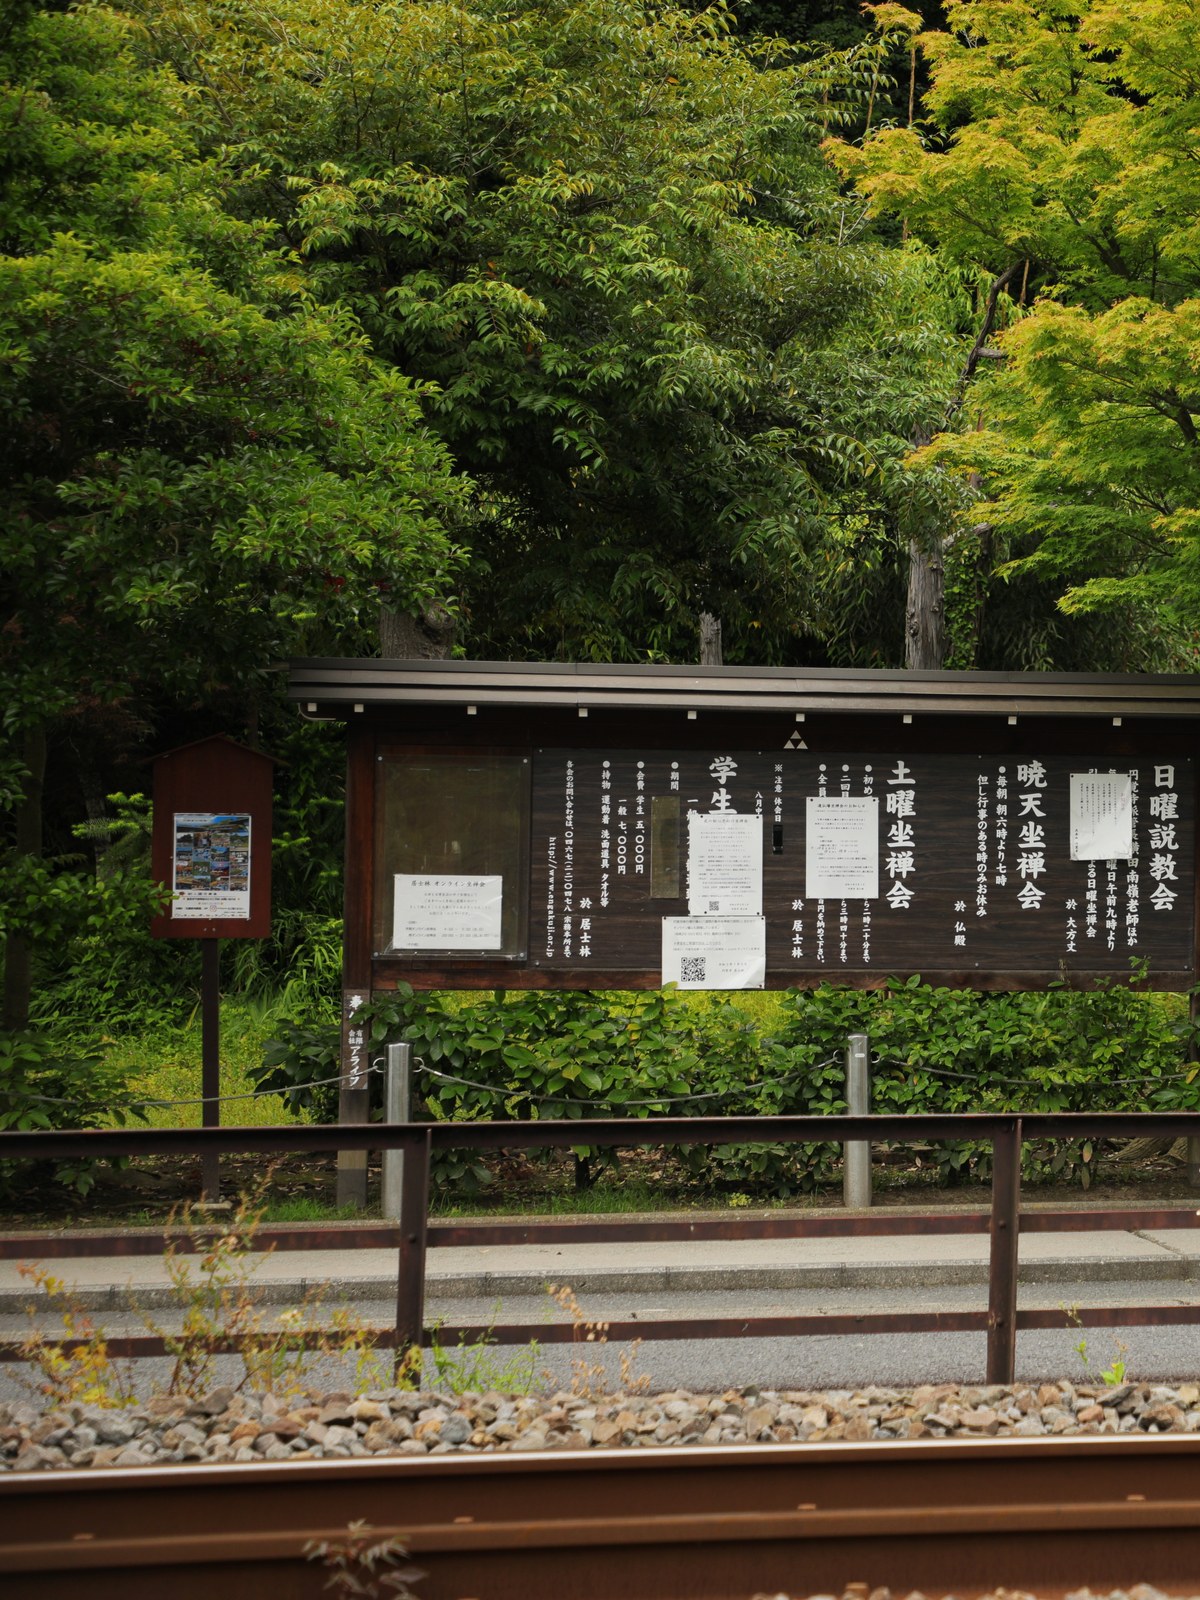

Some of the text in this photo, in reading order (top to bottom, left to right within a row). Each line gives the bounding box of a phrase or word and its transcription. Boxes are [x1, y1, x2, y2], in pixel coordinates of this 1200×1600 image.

[617, 799, 628, 816] 一般
[635, 795, 645, 815] 学生
[636, 770, 645, 791] 会費
[670, 771, 680, 791] 期間
[708, 755, 739, 814] 学生
[774, 797, 783, 823] 休会日
[599, 769, 612, 908] 持物 運動着 洗面道具 タオル等
[884, 760, 917, 909] 土曜坐禅会
[975, 774, 989, 918] 但し行事のある時のみお休み
[995, 775, 1008, 887] 毎朝 朝六時より七時
[1015, 760, 1048, 910] 暁天坐禅会
[1147, 765, 1180, 911] 日曜説教会
[579, 897, 593, 958] 於 居士林
[791, 899, 805, 959] 於 居士林
[954, 900, 967, 946] 於 仏殿
[1065, 898, 1078, 952] 於 大方丈
